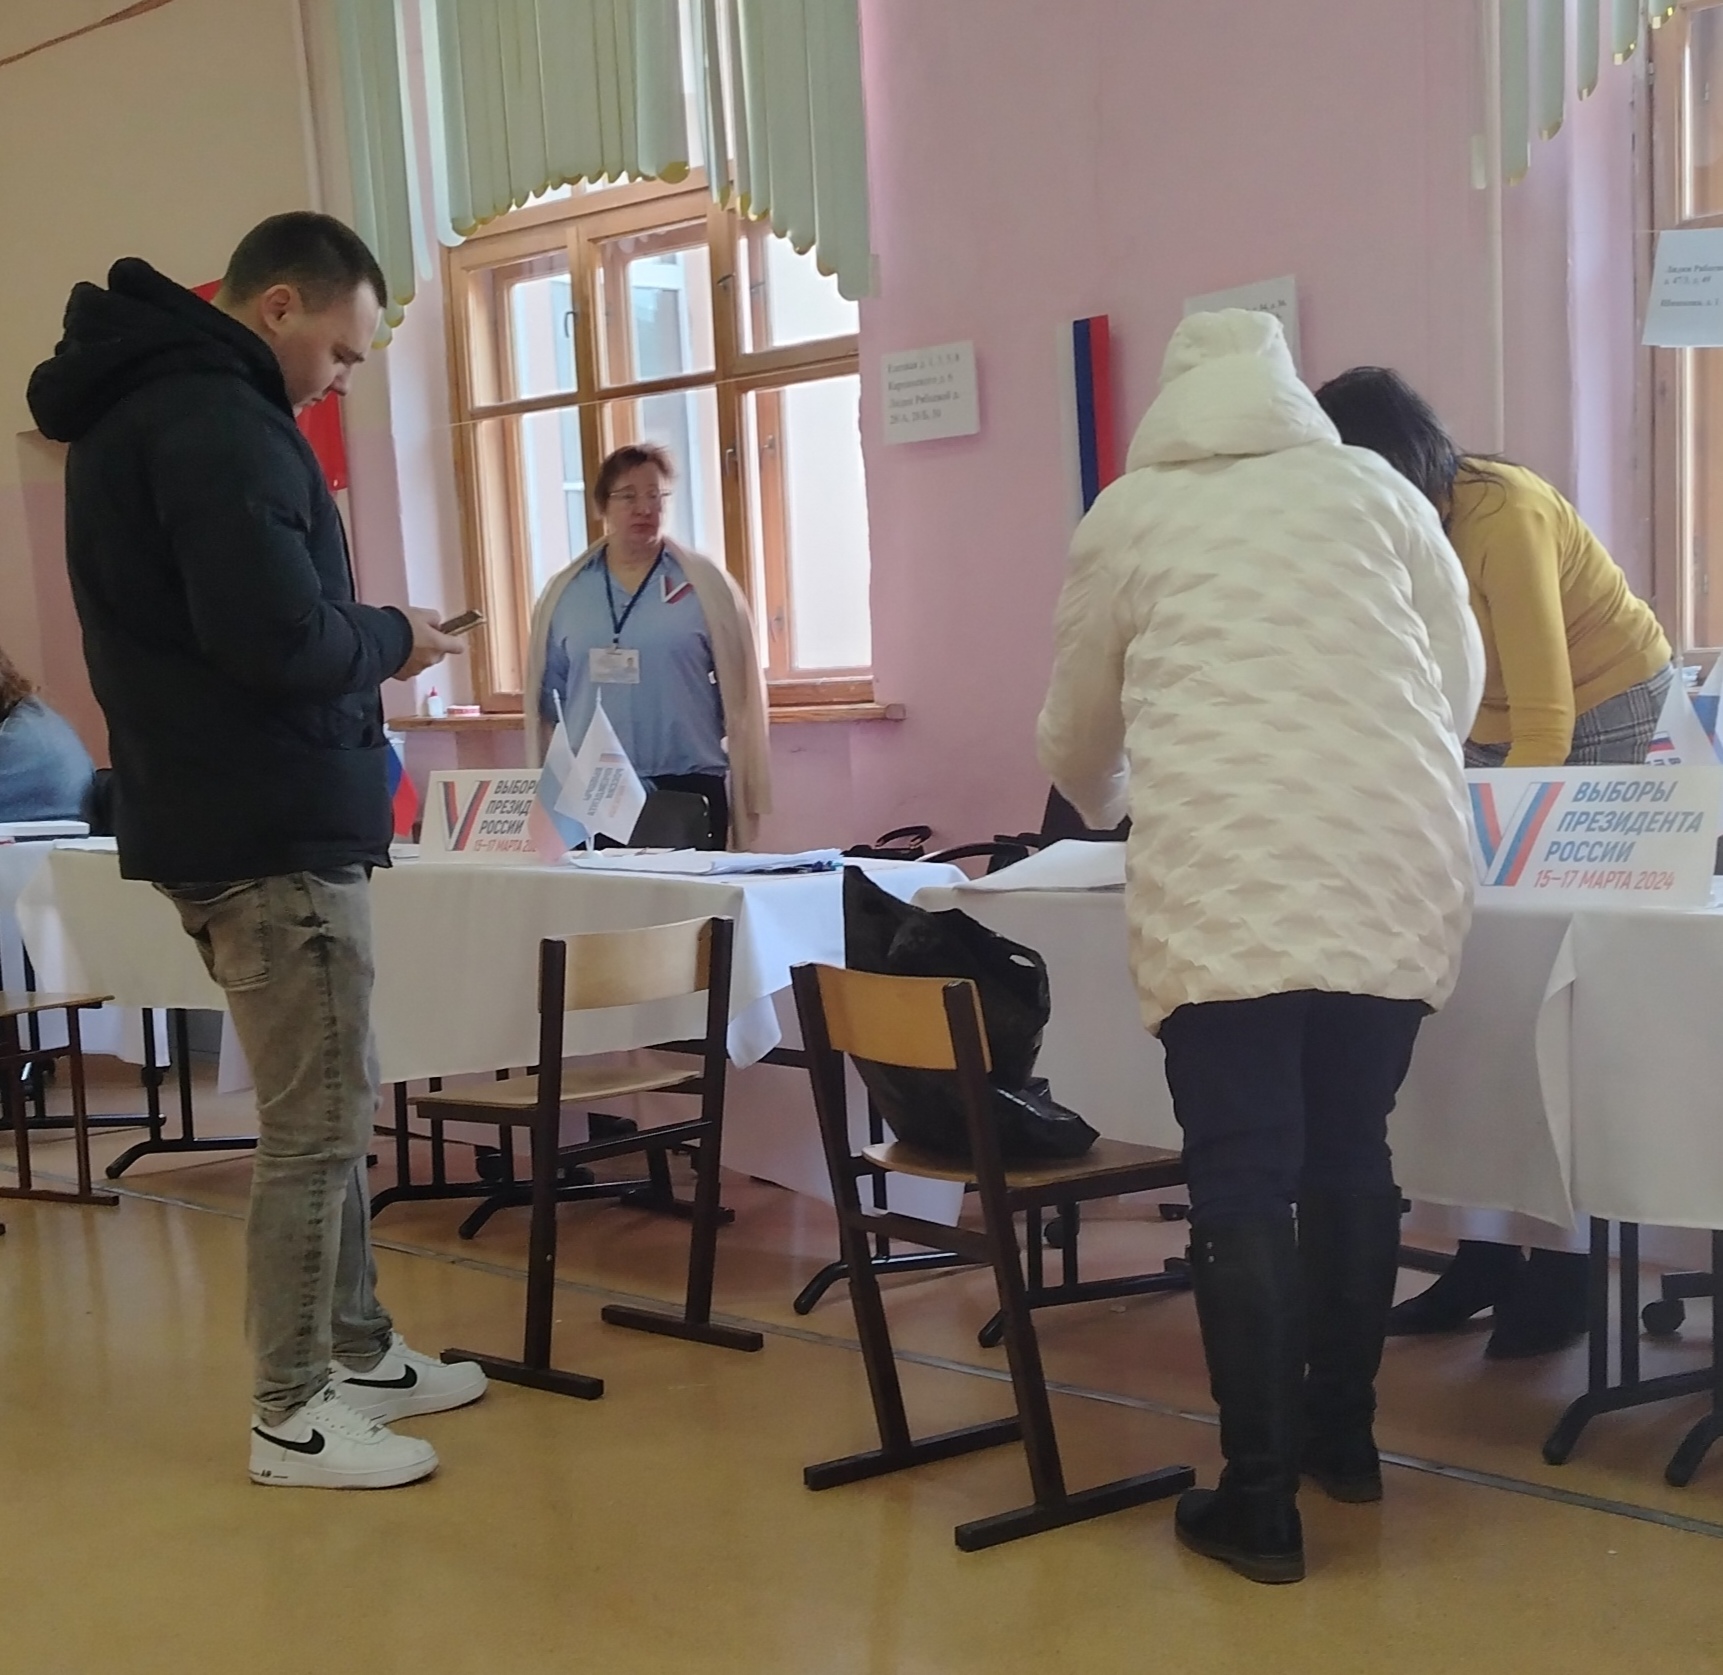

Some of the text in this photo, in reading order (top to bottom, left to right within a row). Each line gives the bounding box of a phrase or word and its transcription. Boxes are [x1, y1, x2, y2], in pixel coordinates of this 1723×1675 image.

[1572, 780, 1678, 803] ВЫБОРЫ
[485, 799, 533, 816] ПРЕЗИД
[478, 819, 525, 835] РОССИИ
[1556, 810, 1704, 836] ПРЕЗИДЕНТА
[1544, 840, 1636, 863] РОССИИ
[1579, 870, 1632, 889] МАРТА
[1633, 870, 1675, 890] 2024
